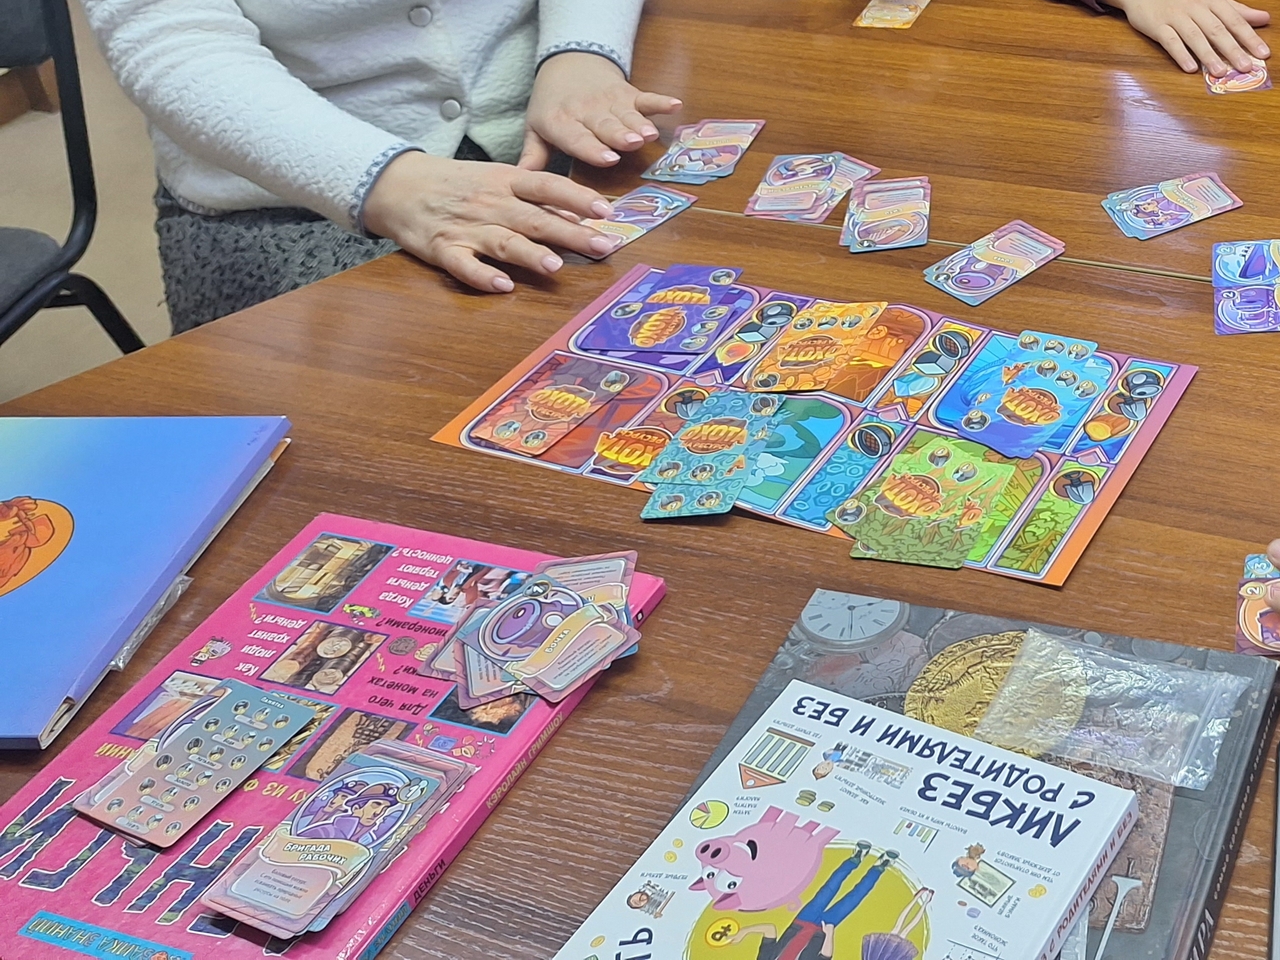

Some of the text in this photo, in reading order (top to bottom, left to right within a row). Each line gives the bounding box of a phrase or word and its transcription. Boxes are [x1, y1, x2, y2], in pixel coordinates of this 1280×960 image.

[529, 388, 592, 418] ОХОТА
[1001, 390, 1062, 425] ОХОТА
[679, 423, 748, 446] ОХОТА
[595, 431, 664, 466] ХОТА
[882, 477, 942, 516] ОХОТА
[391, 546, 453, 564] ценность?
[397, 563, 440, 578] теряют
[386, 577, 431, 592] деньги
[378, 591, 415, 608] Когда
[253, 613, 308, 629] деньги?
[376, 617, 449, 636] лионерами?
[247, 629, 291, 644] хранят
[544, 629, 571, 653] Бочка
[240, 644, 278, 658] люди
[234, 661, 260, 677] Как
[368, 676, 439, 698] на монетах
[368, 695, 429, 716] Для чего
[485, 712, 565, 810] КЭРОЛАЙН ГРИМШОУ
[792, 695, 1097, 810] С РОДИТЕЛЯМИ И БЕЗ
[266, 781, 289, 798] ИЗ
[917, 772, 1082, 848] ЛИКБЕЗ
[283, 842, 332, 853] БРИГАДА
[298, 852, 347, 866] РАБОЧИХ
[412, 858, 448, 904] ДЕНЬГИ
[1031, 869, 1042, 880] ОНИ
[1044, 873, 1055, 884] ЧЕМ
[1056, 851, 1111, 940] РОДИТЕЛЯМИ
[1116, 811, 1134, 839] БЕЗ
[27, 916, 100, 948] ЗНАНИЙ
[973, 924, 1009, 947] ЭКОНОМИКА?
[971, 933, 999, 952] ЧТО ТАКОЕ
